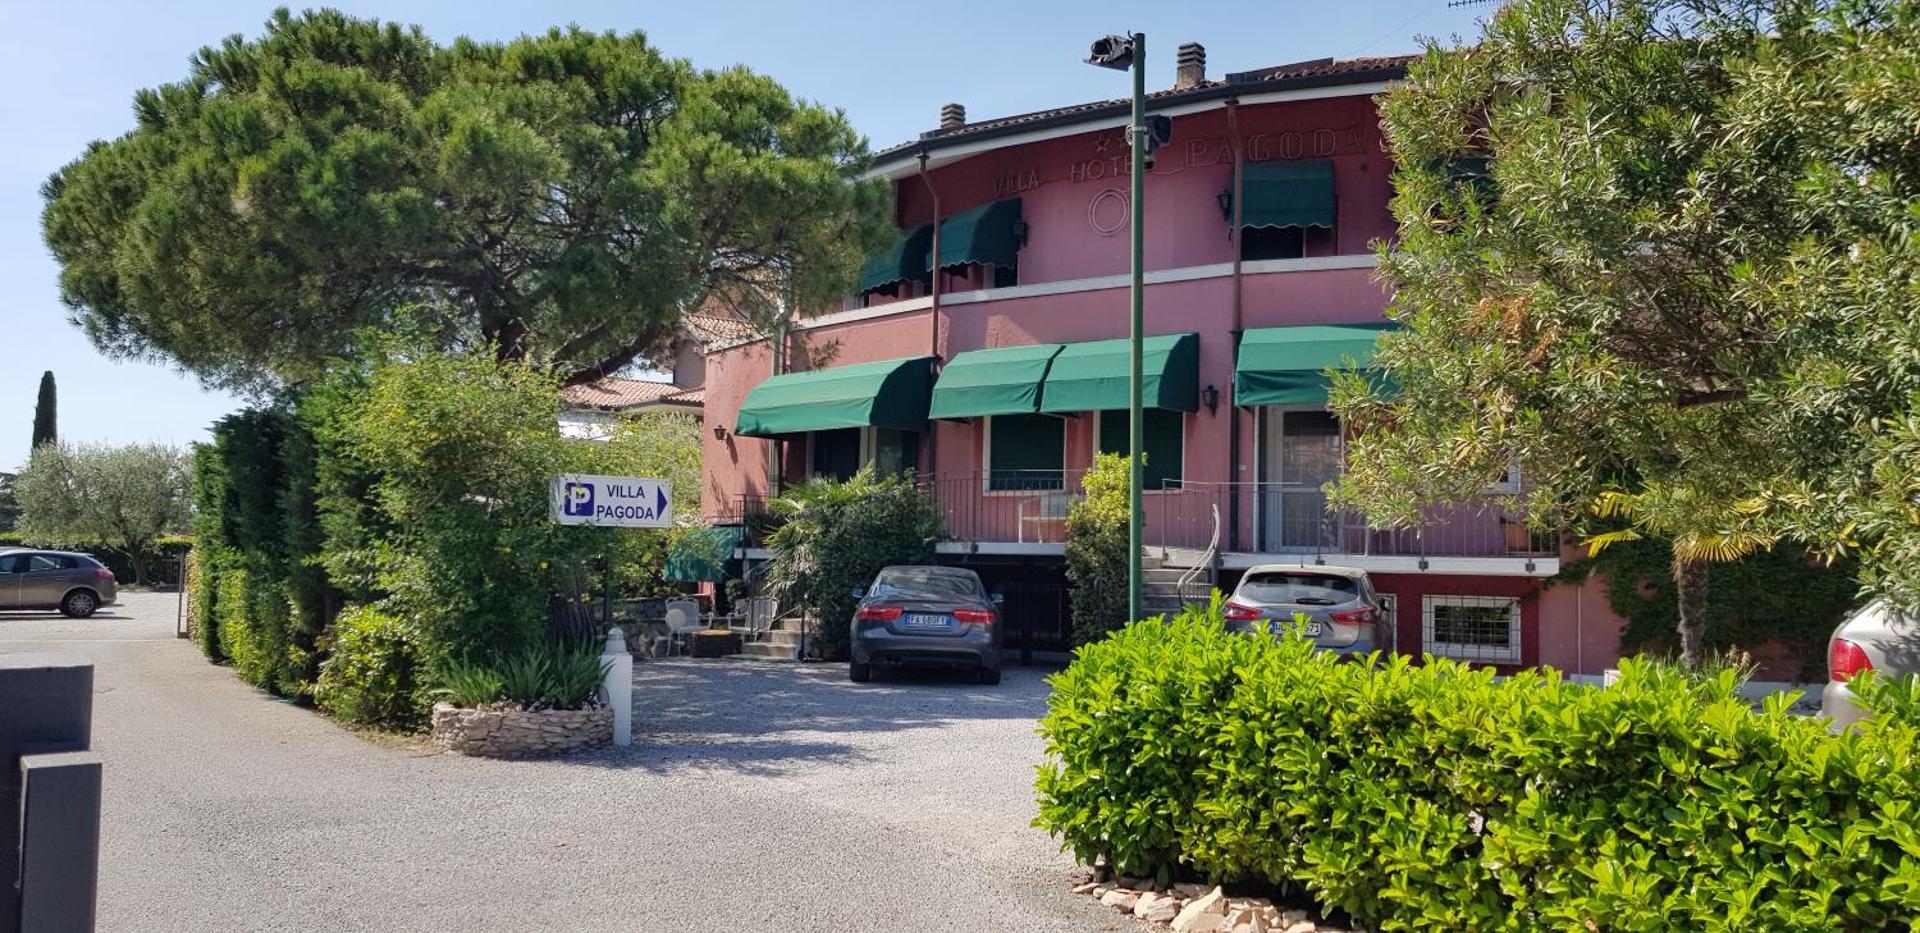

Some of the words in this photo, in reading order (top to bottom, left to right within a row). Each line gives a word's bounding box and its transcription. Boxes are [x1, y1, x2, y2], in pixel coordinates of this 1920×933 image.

[994, 169, 1040, 196] VILLA
[1071, 153, 1138, 183] HOTE
[1186, 124, 1363, 166] PAGODA
[570, 486, 591, 514] P
[607, 484, 645, 498] VILLA
[597, 505, 654, 520] PAGODA
